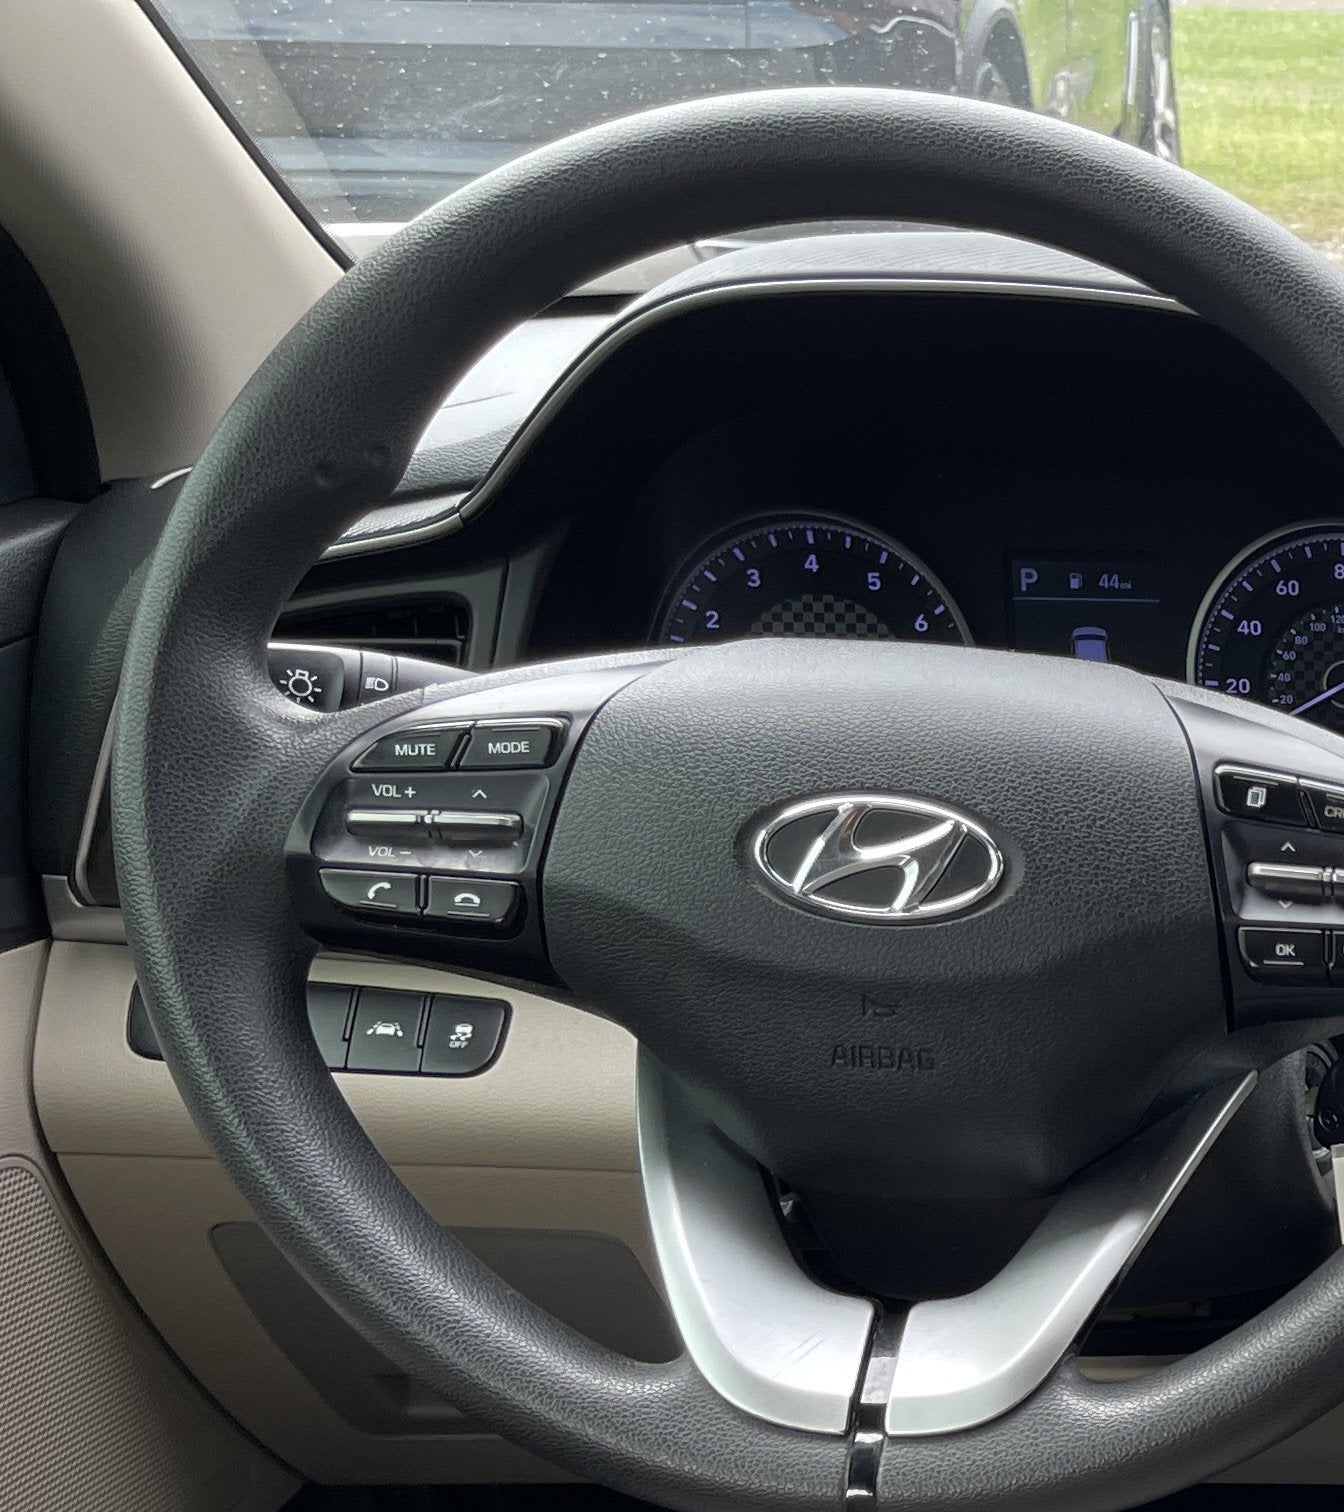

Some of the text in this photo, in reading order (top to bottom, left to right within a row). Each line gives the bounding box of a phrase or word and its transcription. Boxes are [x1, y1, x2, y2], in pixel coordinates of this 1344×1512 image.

[804, 553, 819, 573] 4
[746, 569, 761, 588] 3
[867, 572, 881, 591] 5
[1020, 567, 1038, 592] P
[1275, 579, 1300, 597] 60
[704, 610, 720, 629] 2
[914, 613, 928, 632] 6
[1236, 619, 1262, 637] 40
[1309, 622, 1327, 634] 100
[1294, 635, 1308, 646] 80
[1282, 650, 1297, 662] 60
[1277, 672, 1292, 683] 40
[1225, 678, 1250, 695] 20
[1279, 694, 1294, 705] 20
[395, 743, 436, 756] MUTE
[488, 741, 530, 755] MODE
[1275, 943, 1296, 957] OK
[831, 1045, 935, 1071] AIRBAG
